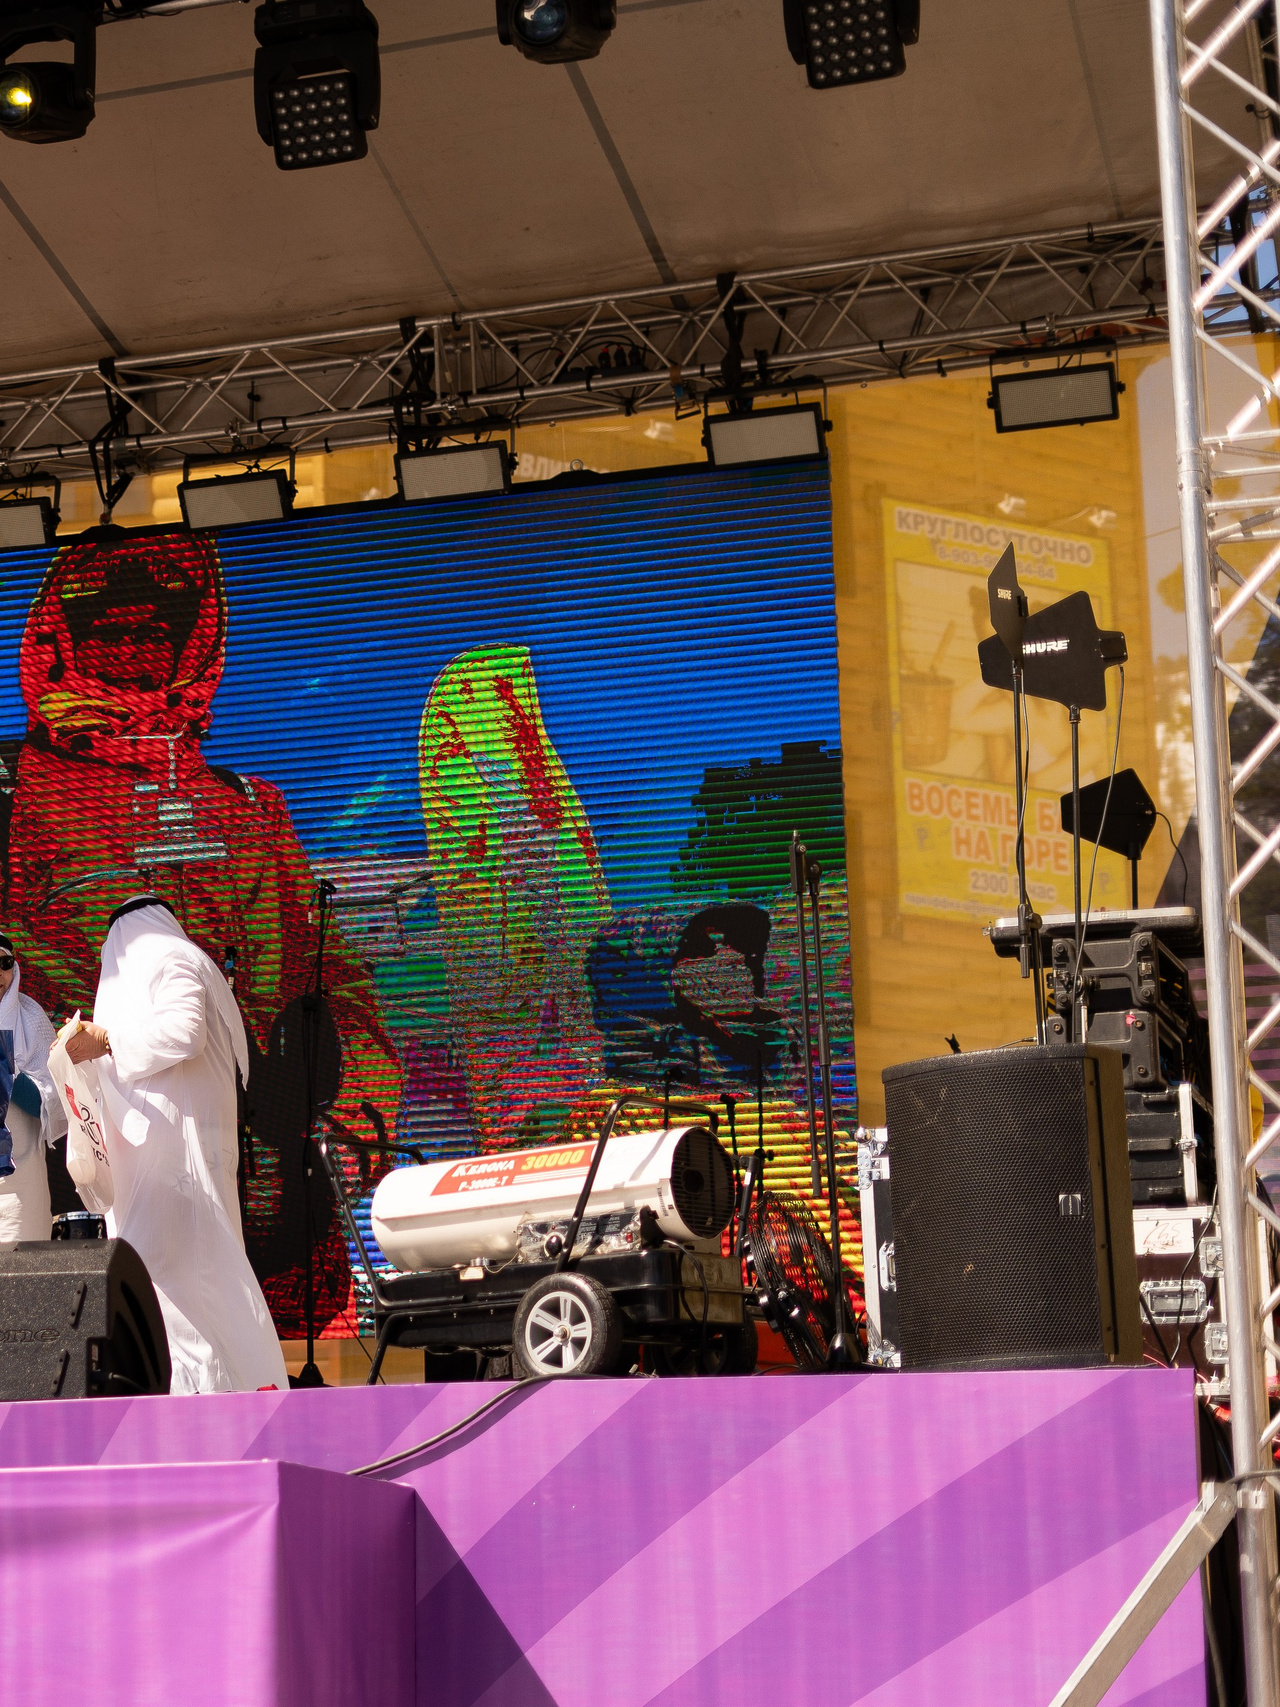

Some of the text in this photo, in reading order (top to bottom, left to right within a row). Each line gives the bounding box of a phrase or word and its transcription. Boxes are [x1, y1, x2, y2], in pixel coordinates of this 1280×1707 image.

[895, 507, 1093, 567] КРУГЛОСУТОЧНО
[1022, 639, 1070, 655] HURE
[906, 780, 1017, 827] ВОСЕМЬ
[953, 825, 993, 862] НА
[970, 870, 1009, 896] 2300
[521, 1149, 586, 1171] 30000
